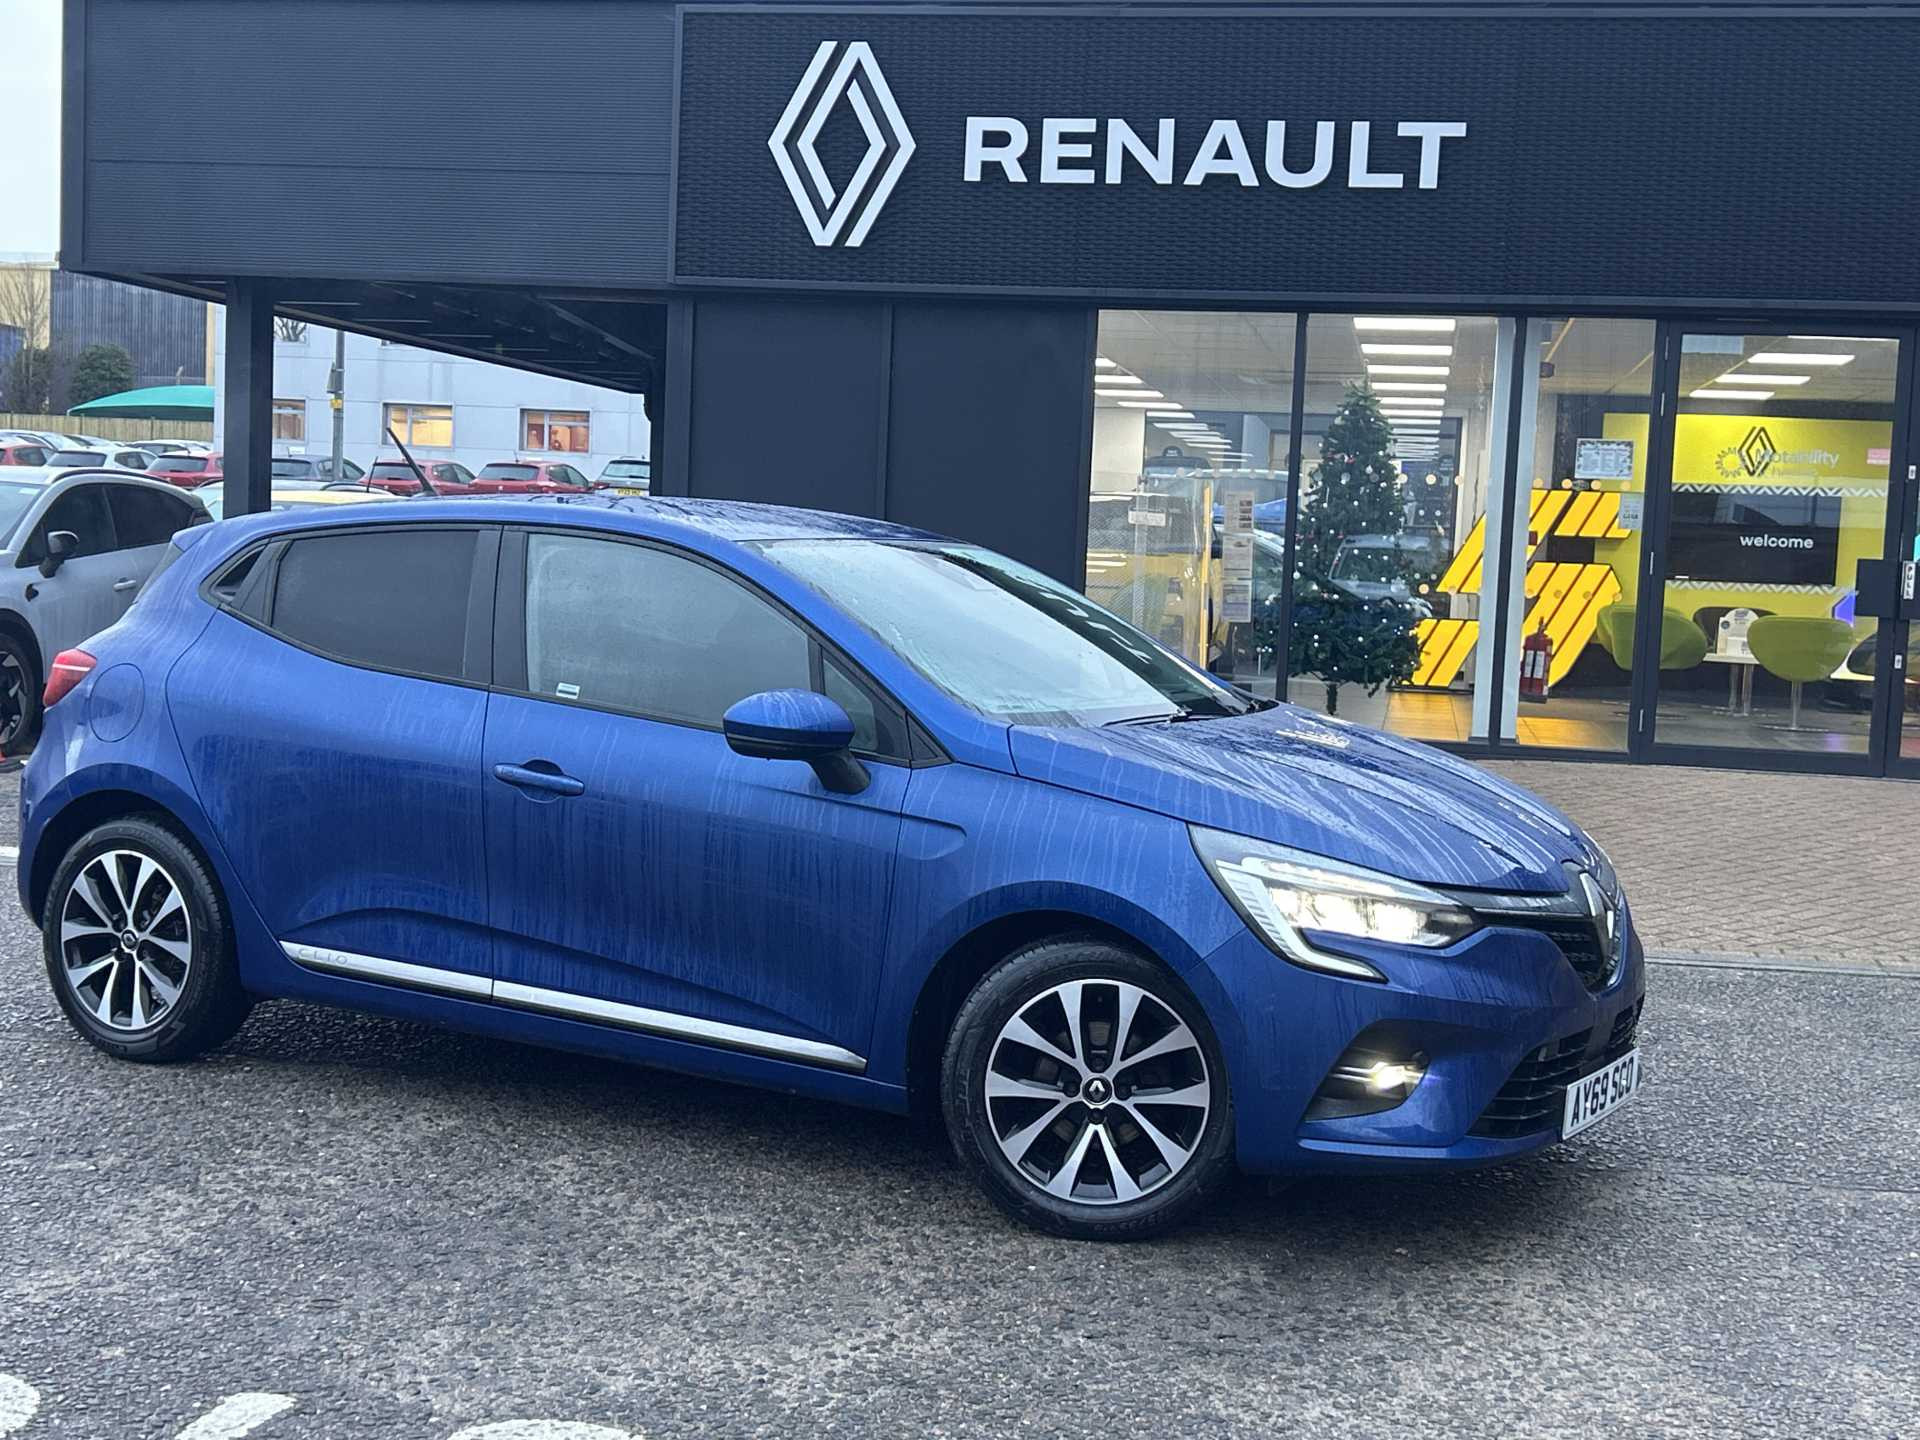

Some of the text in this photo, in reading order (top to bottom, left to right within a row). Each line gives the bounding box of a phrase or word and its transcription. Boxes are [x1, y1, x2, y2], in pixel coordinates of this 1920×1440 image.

[963, 116, 1467, 189] RENAULT
[1740, 534, 1814, 549] welcome
[1571, 1072, 1609, 1126] AY69
